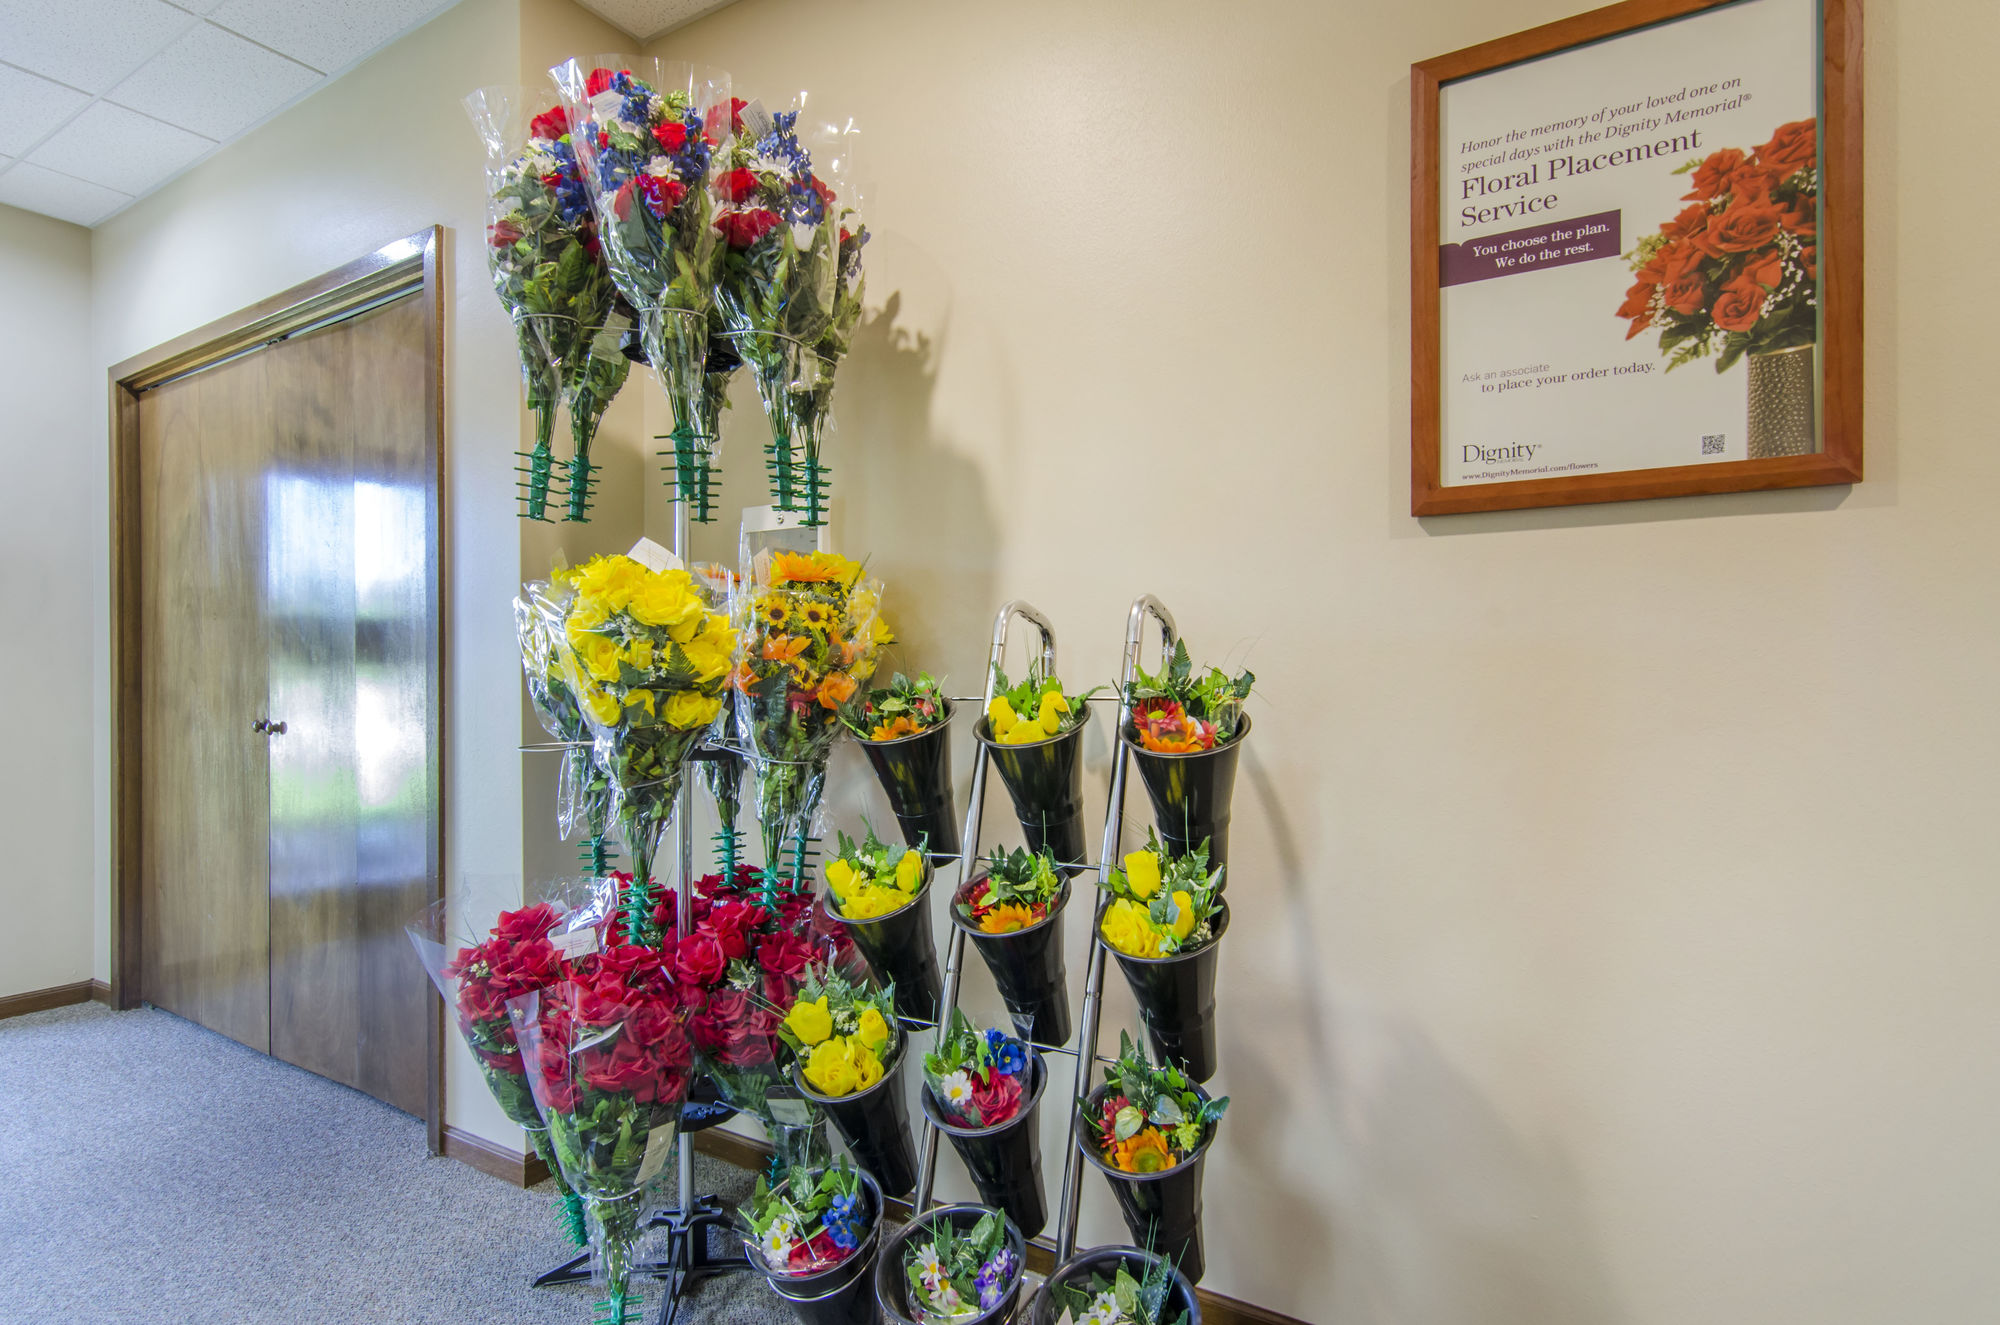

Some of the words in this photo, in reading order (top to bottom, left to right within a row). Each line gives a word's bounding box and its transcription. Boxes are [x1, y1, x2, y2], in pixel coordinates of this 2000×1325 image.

[1460, 135, 1503, 154] Honor
[1505, 129, 1528, 144] the
[1530, 115, 1588, 138] memory
[1591, 107, 1609, 130] of
[1609, 101, 1643, 122] your
[1646, 88, 1686, 110] loved
[1689, 83, 1718, 99] one
[1721, 78, 1741, 90] on
[1460, 152, 1506, 173] special
[1508, 142, 1541, 161] days
[1543, 136, 1575, 153] with
[1578, 130, 1602, 146] the
[1461, 164, 1539, 200] Floral
[1547, 128, 1703, 181] Placement
[1461, 193, 1558, 228] Service
[1472, 245, 1498, 257] You
[1501, 234, 1548, 252] choose
[1551, 228, 1573, 242] the
[1576, 222, 1610, 239] plan.
[1495, 257, 1516, 269] We
[1518, 253, 1536, 264] do
[1539, 248, 1561, 260] the
[1564, 241, 1594, 255] rest.
[1462, 372, 1481, 383] Ask
[1484, 370, 1497, 381] an
[1500, 363, 1550, 378] associate
[1481, 383, 1495, 393] to
[1498, 378, 1533, 394] place
[1536, 373, 1568, 388] your
[1571, 366, 1610, 381] order
[1613, 361, 1656, 376] today.
